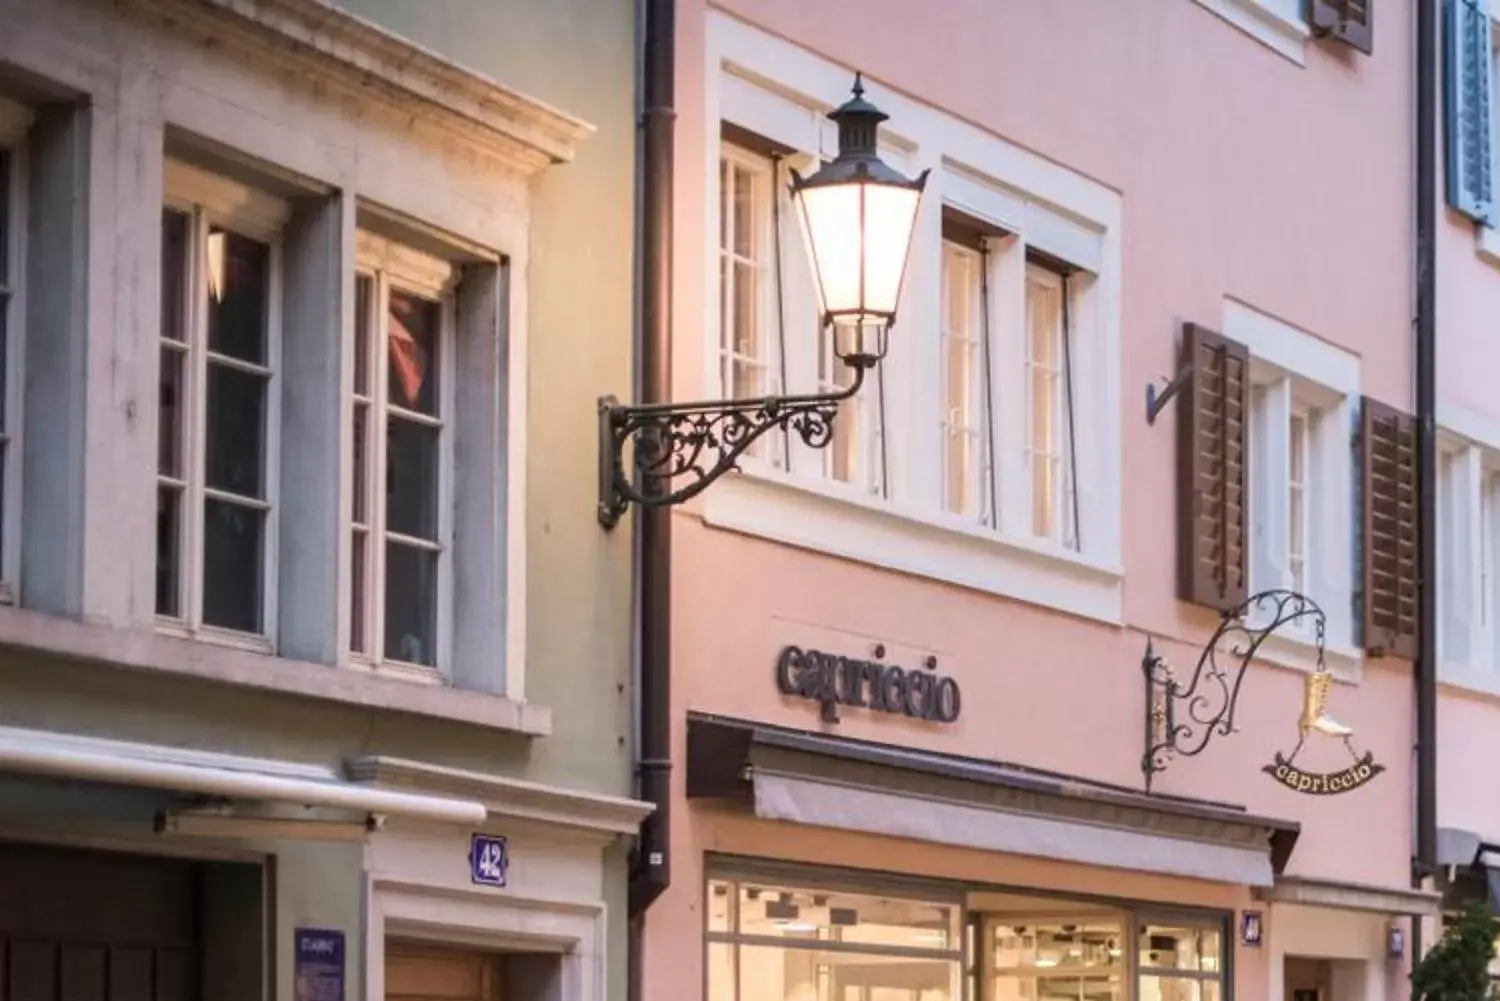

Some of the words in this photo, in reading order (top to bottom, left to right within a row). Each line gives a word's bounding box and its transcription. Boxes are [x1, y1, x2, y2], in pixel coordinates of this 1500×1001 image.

[777, 642, 961, 724] capriccio
[1275, 764, 1371, 793] capriccio
[479, 842, 502, 878] 42
